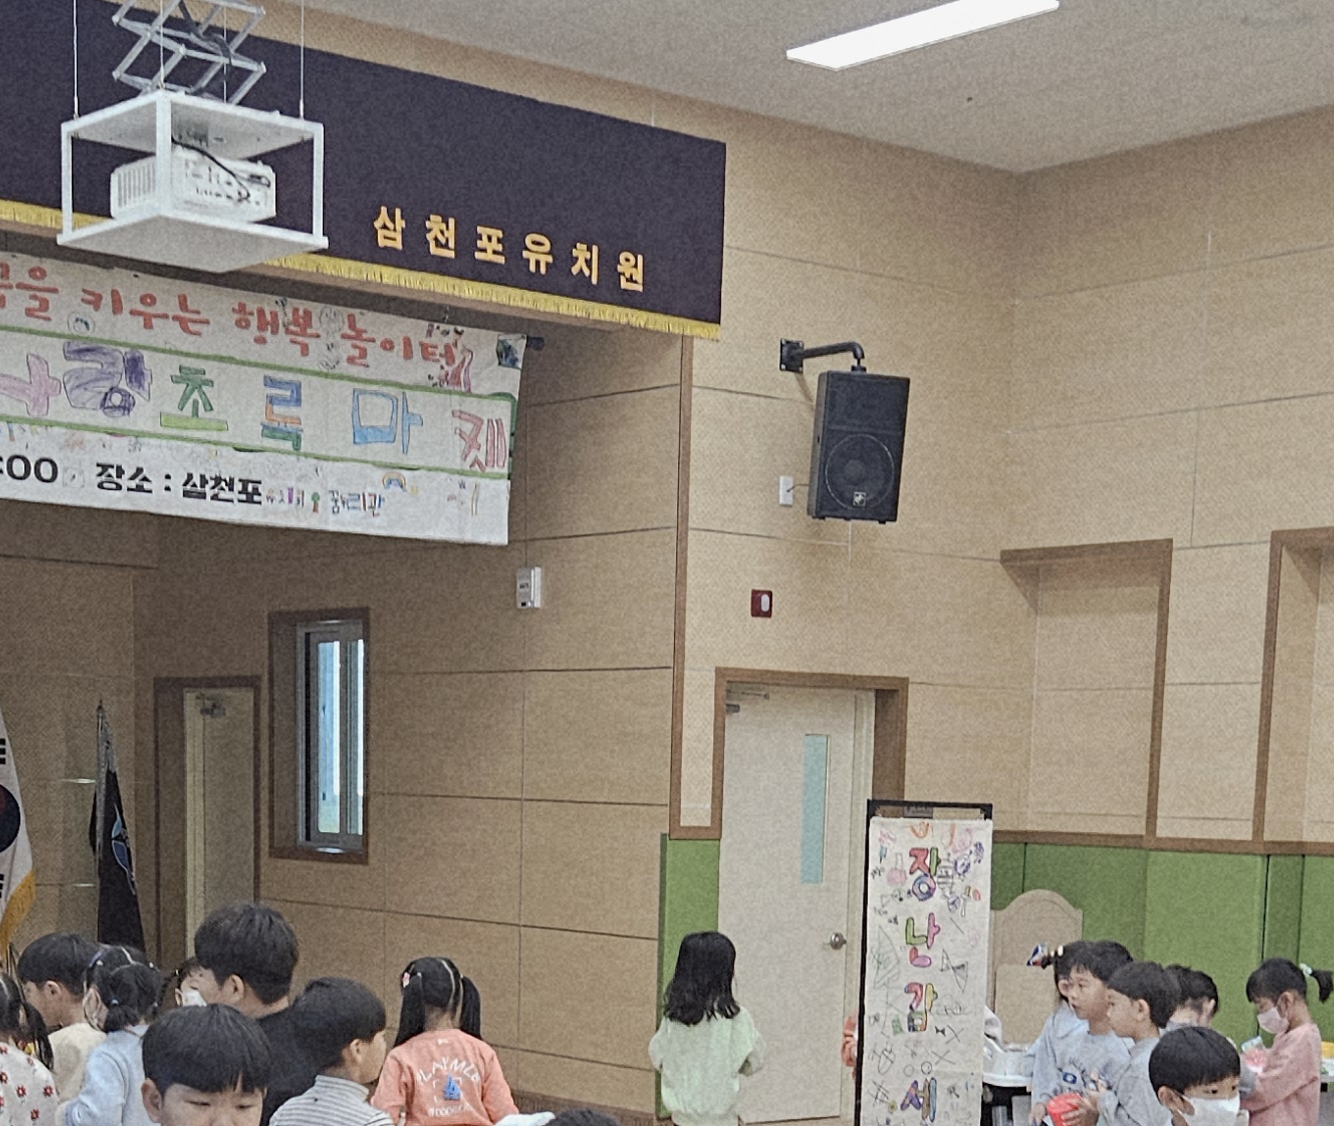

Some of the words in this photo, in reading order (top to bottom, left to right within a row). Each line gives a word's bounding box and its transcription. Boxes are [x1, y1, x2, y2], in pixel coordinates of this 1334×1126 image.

[373, 205, 643, 292] 삼천포유치원
[81, 286, 210, 336] 키우는
[232, 300, 320, 357] 행복
[341, 312, 457, 368] 놀이터
[96, 462, 153, 494] 장소
